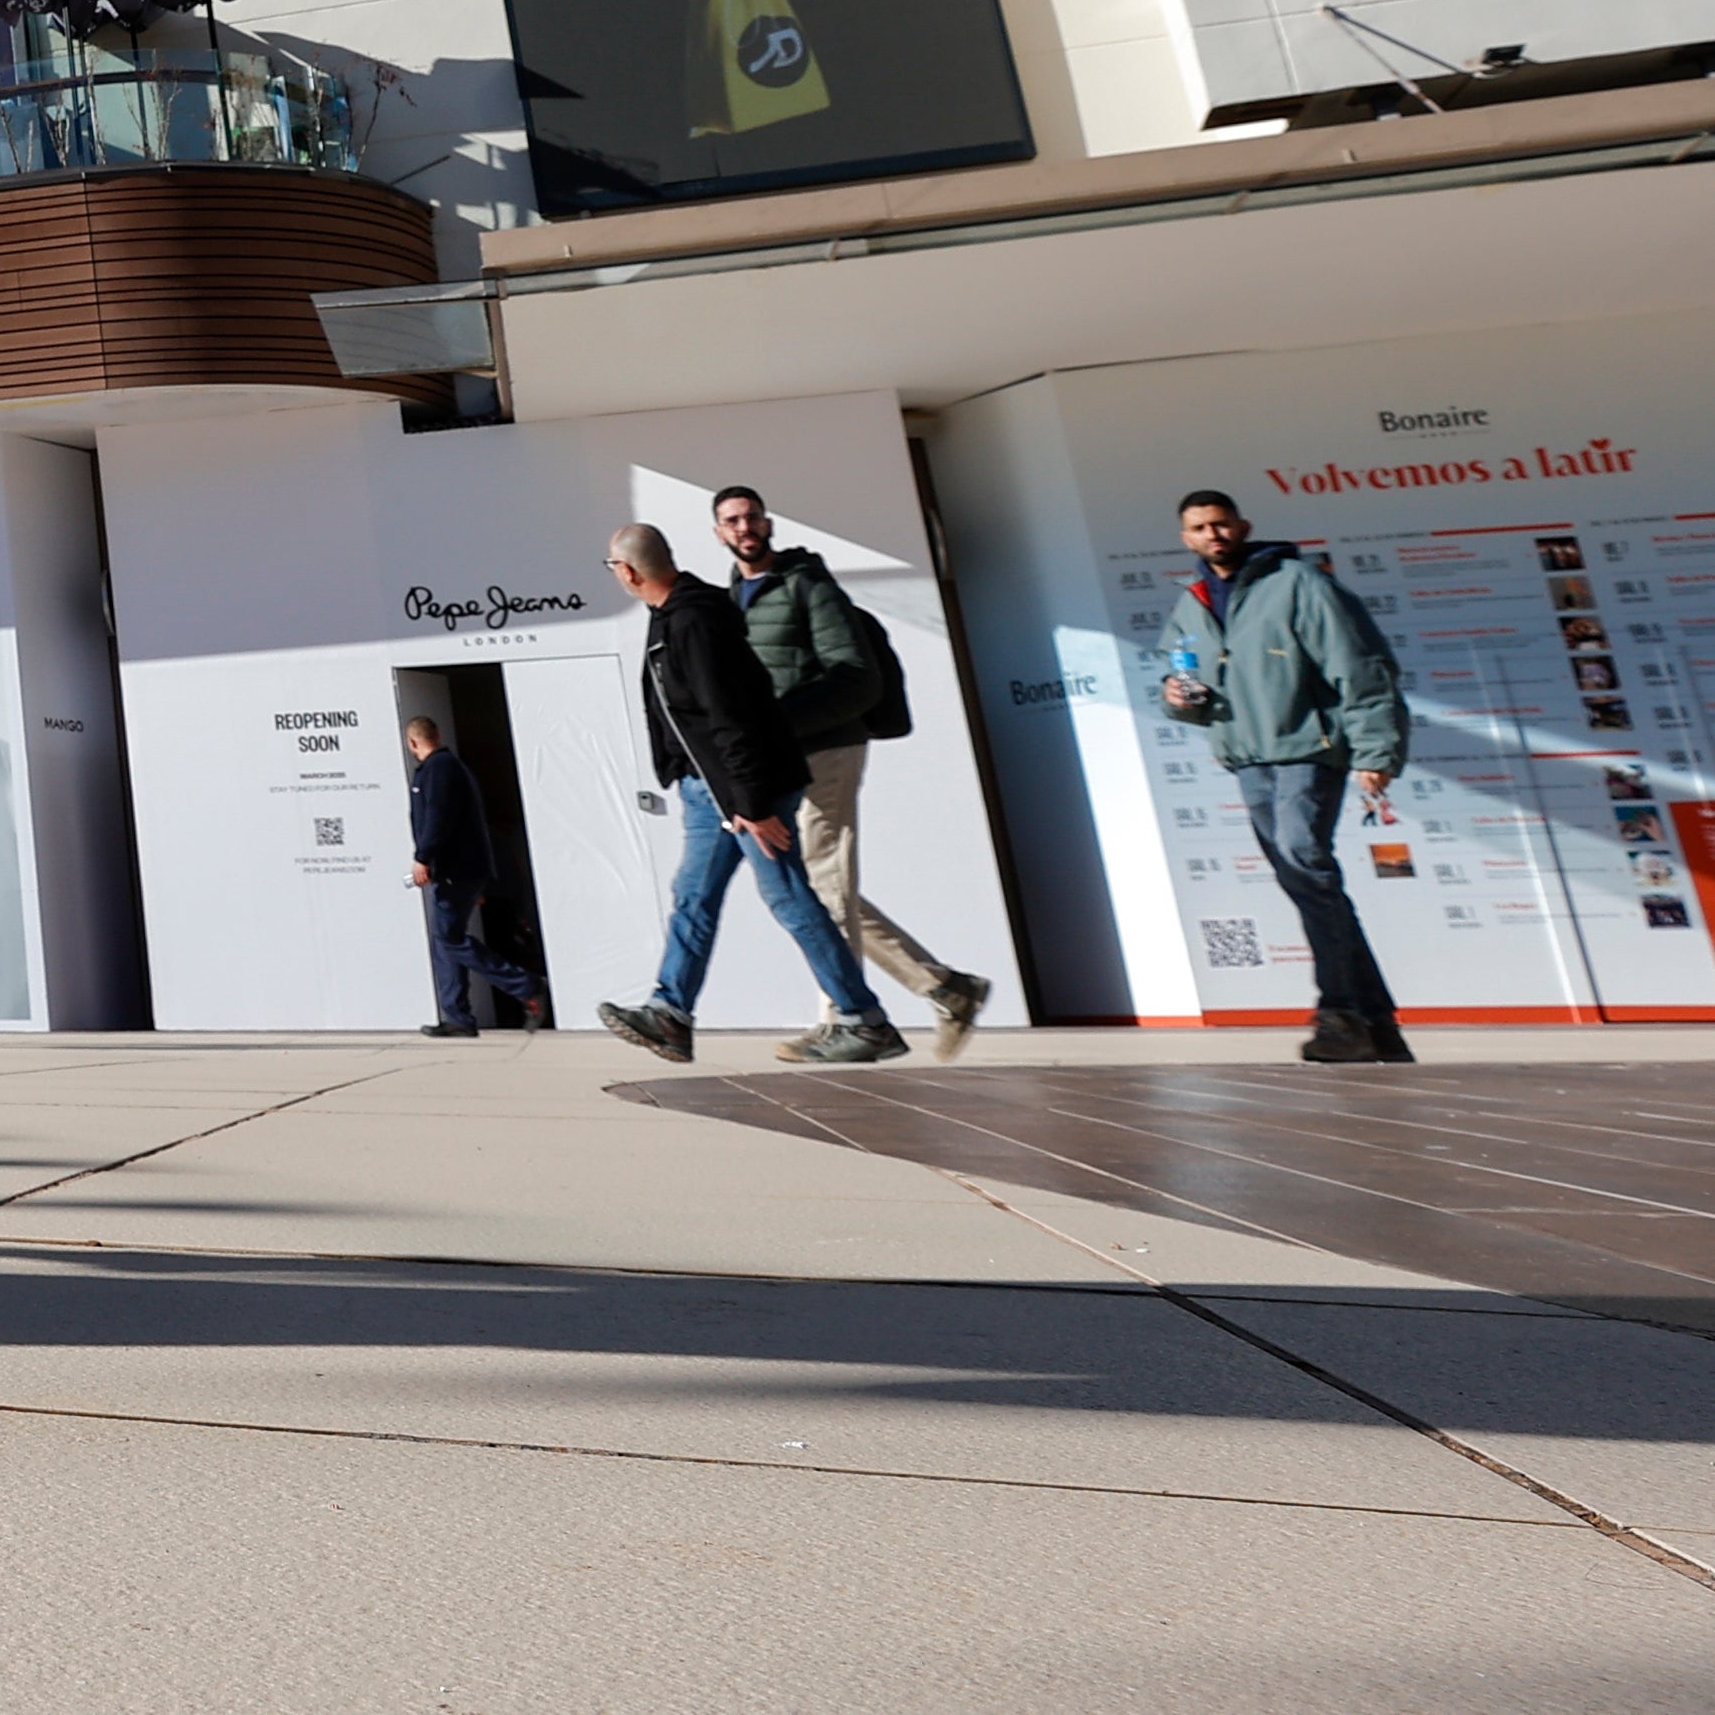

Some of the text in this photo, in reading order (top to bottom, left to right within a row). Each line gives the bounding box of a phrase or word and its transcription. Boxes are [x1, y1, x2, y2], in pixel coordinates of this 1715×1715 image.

[1377, 405, 1491, 435] Bonaire
[1265, 436, 1638, 498] Volvemos a latir
[404, 585, 587, 632] Pepe Jeans
[463, 634, 538, 648] LONDON
[1009, 671, 1099, 707] Bonaire
[43, 716, 85, 733] MANGO
[274, 710, 359, 731] REOPENING
[297, 734, 341, 753] SOON
